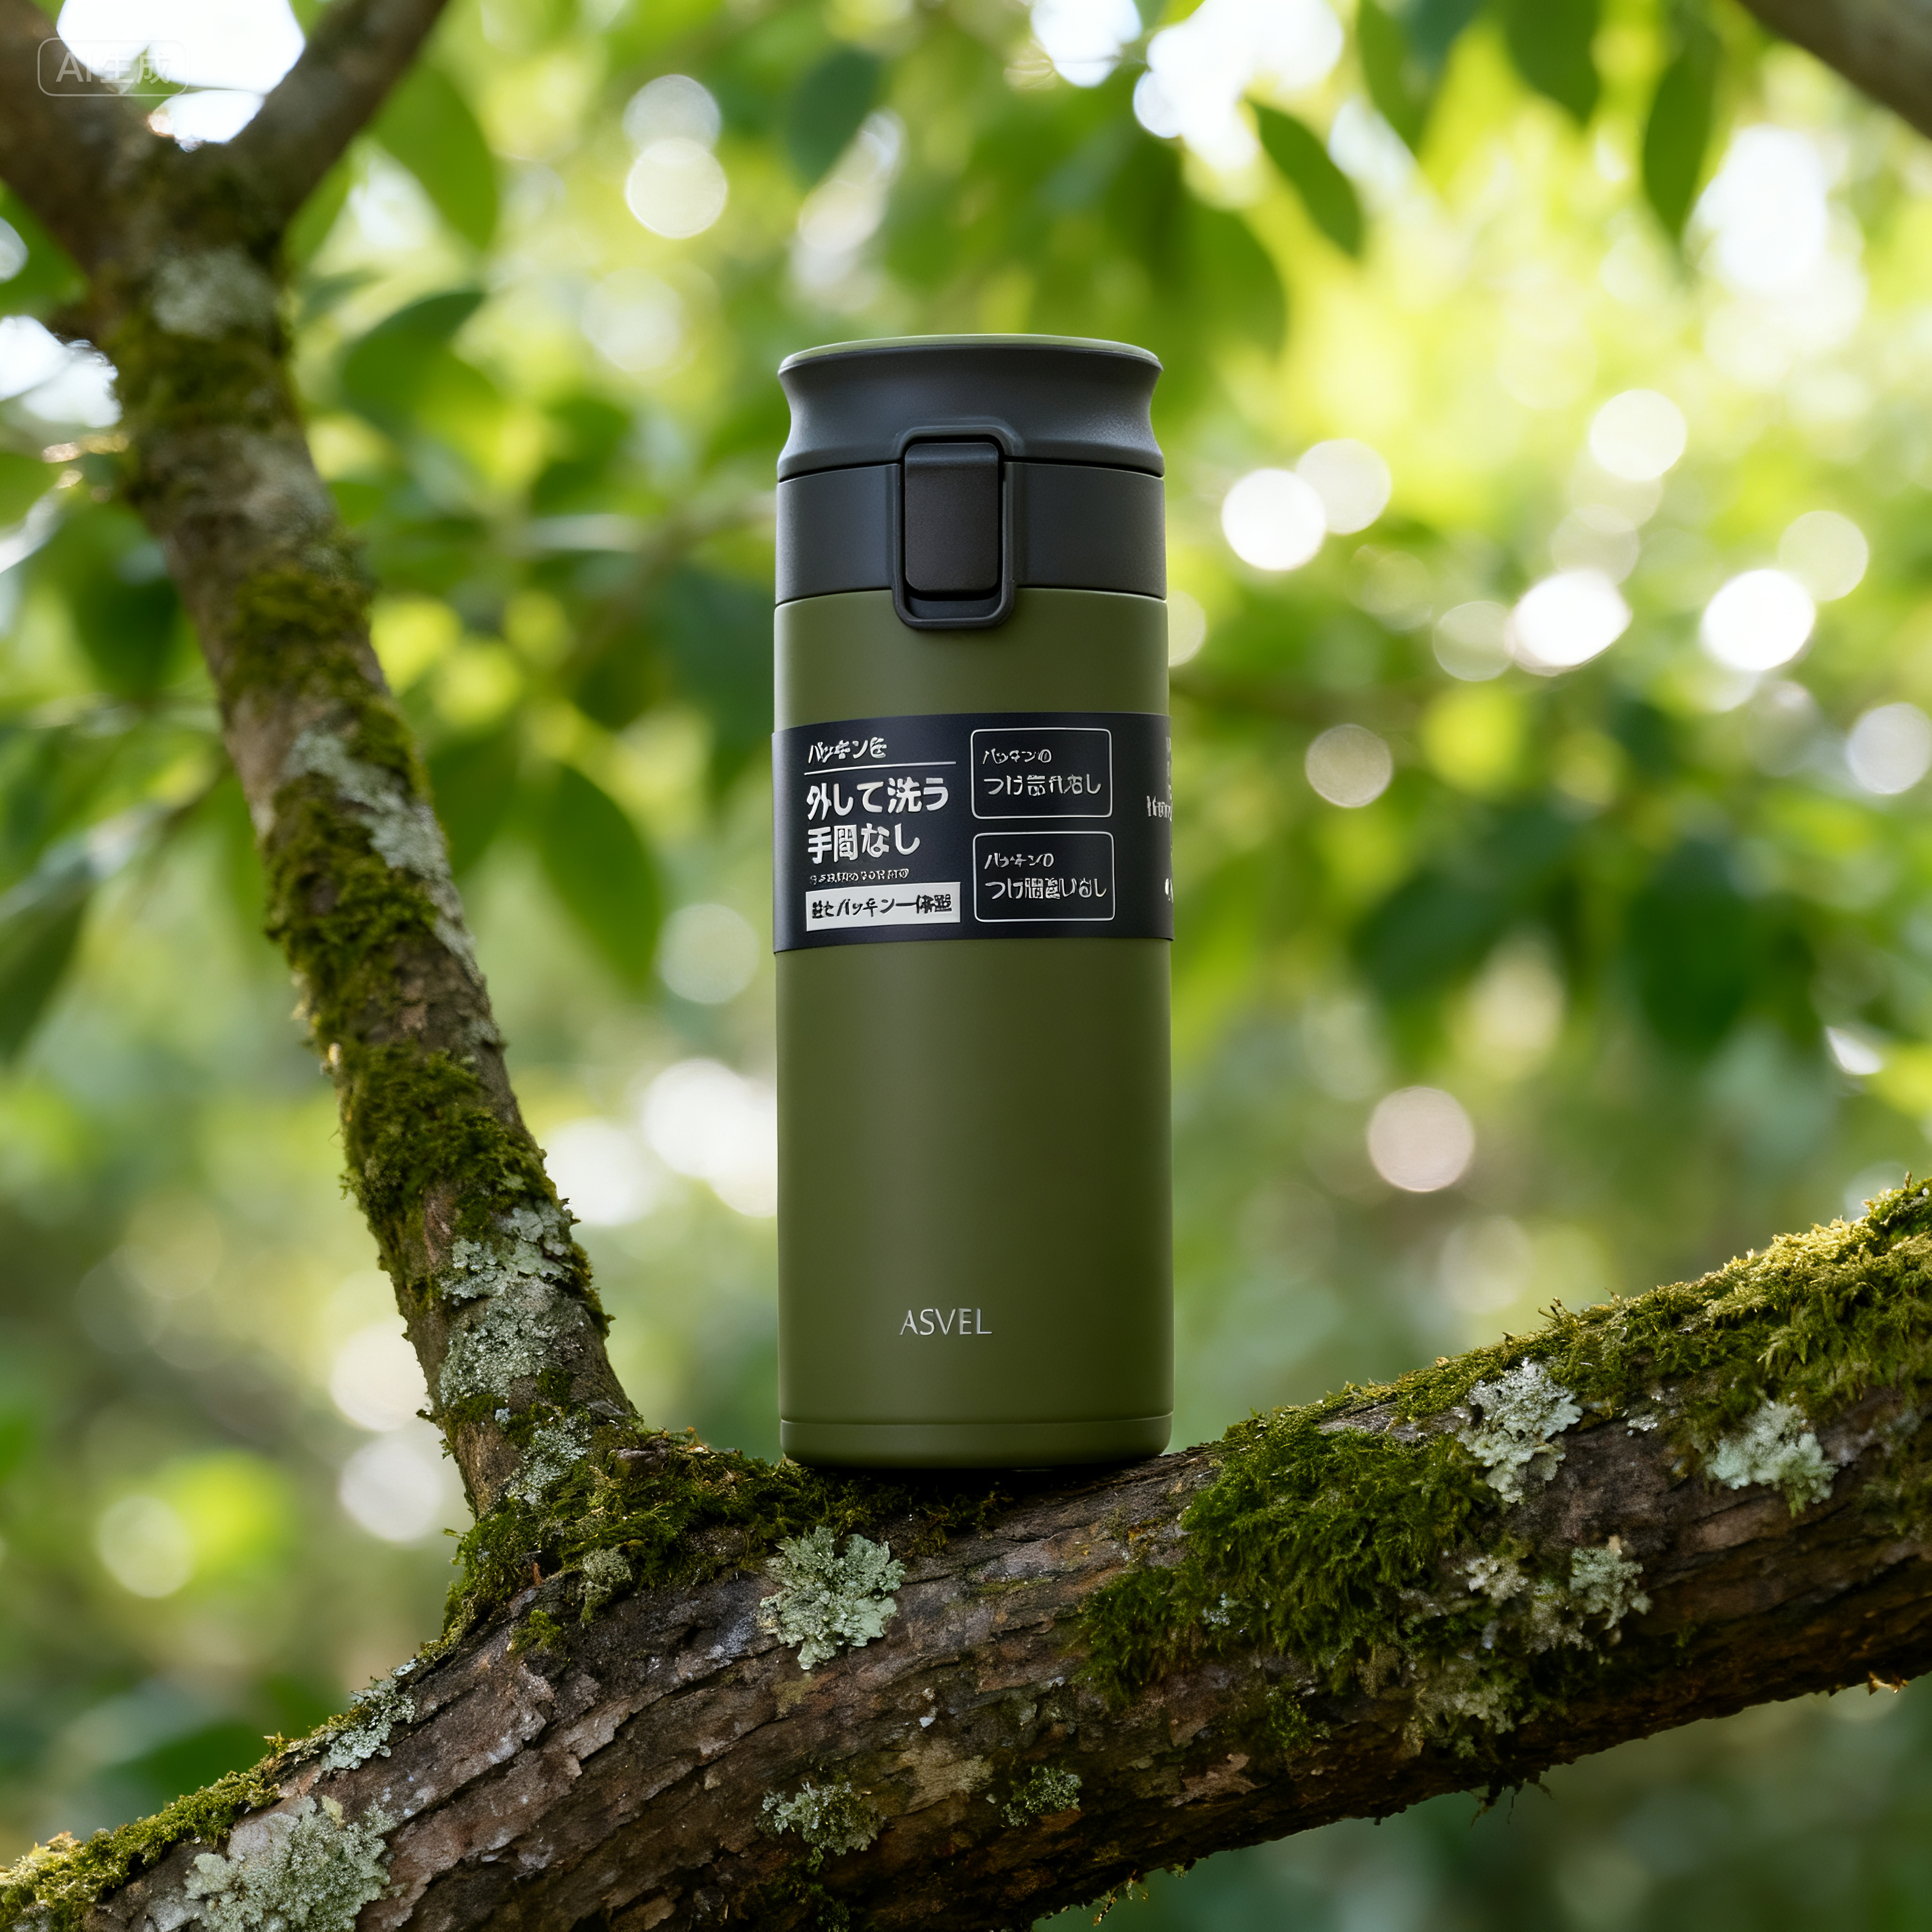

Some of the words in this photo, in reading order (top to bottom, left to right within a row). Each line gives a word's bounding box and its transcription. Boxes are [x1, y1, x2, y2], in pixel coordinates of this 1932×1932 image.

[806, 777, 949, 821] 外して洗う
[808, 823, 921, 864] 手間なし
[899, 1308, 993, 1335] ASVEL
